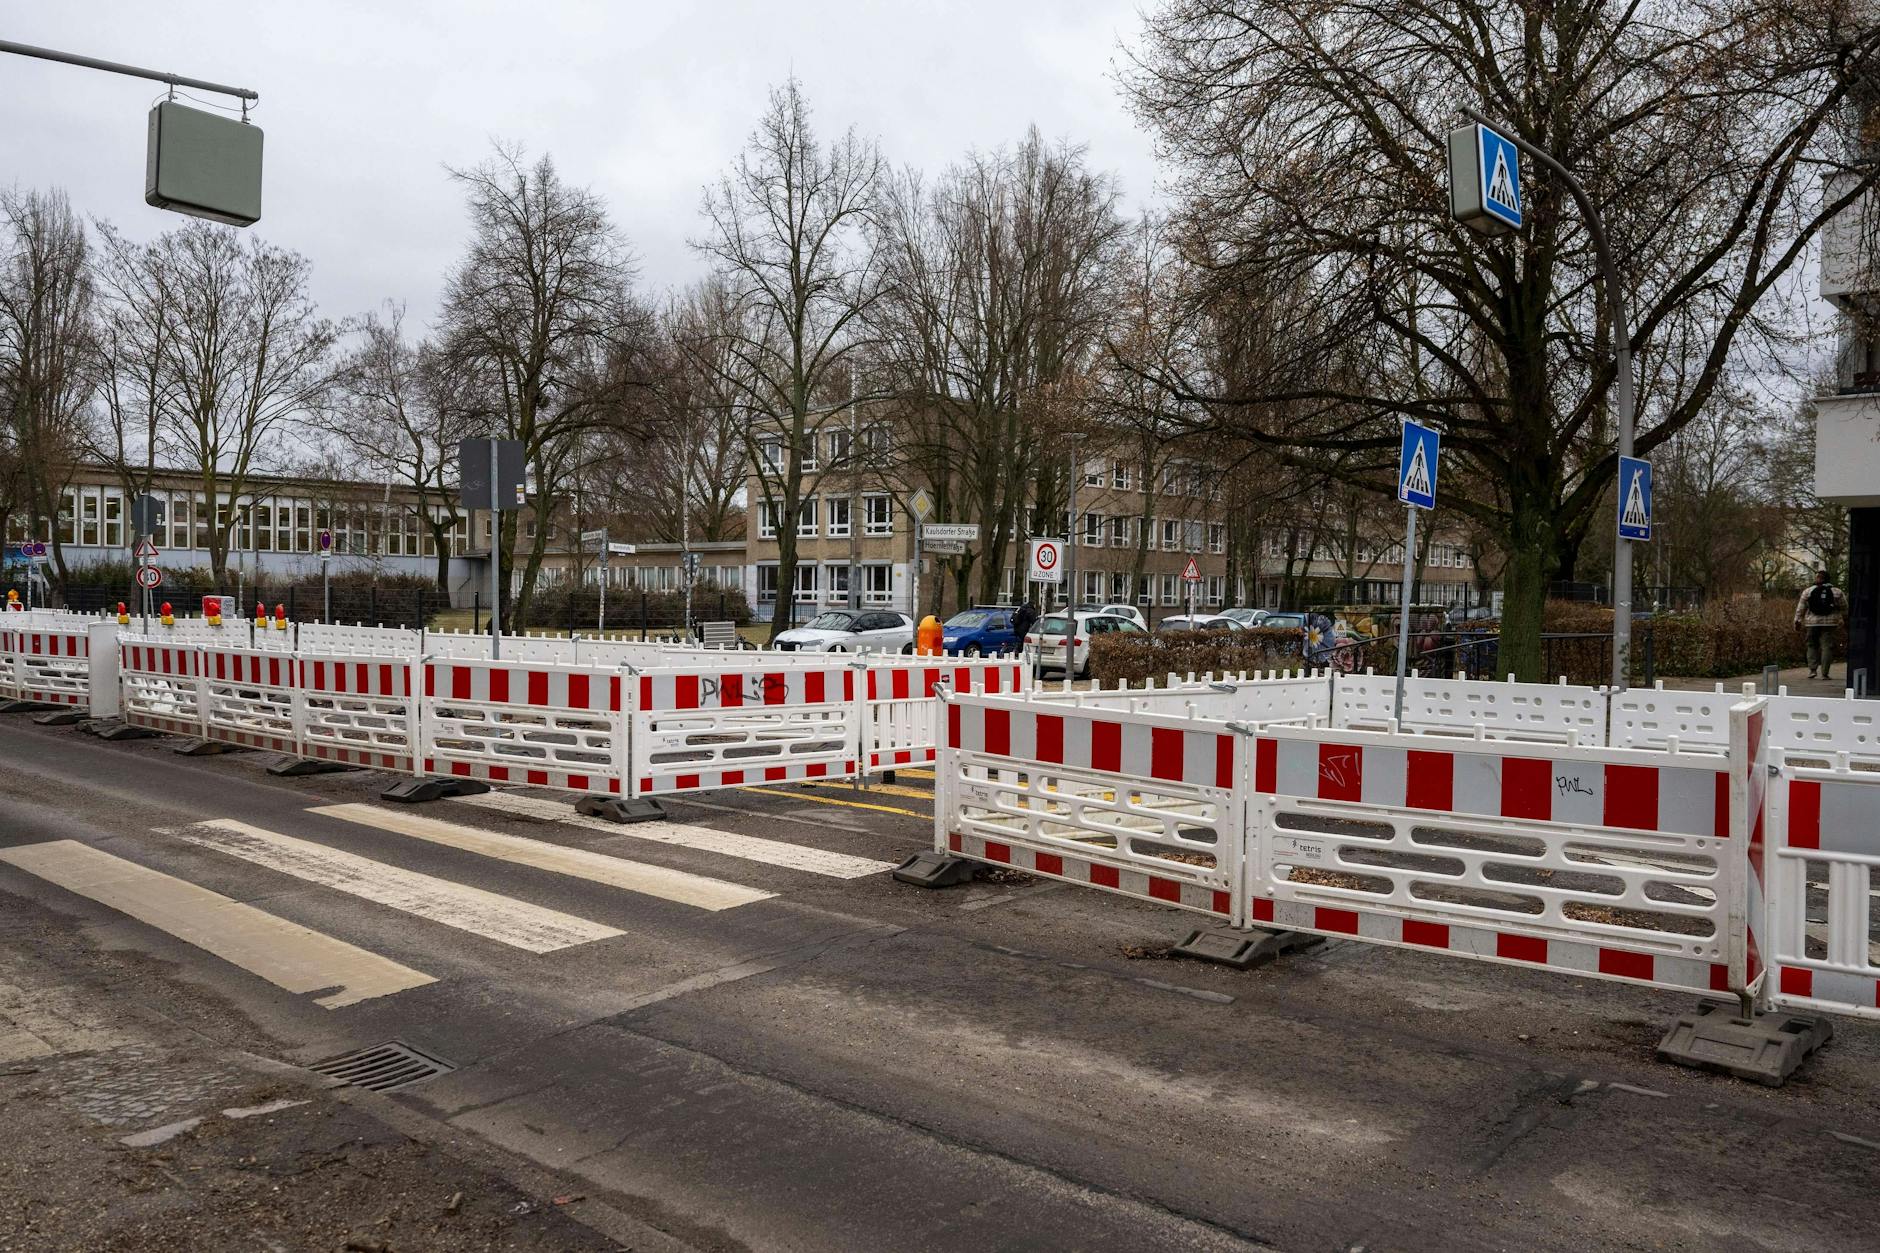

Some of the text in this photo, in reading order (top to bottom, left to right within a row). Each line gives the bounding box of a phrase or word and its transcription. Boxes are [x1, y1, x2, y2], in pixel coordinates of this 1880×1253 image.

[925, 527, 976, 538] Kaulsdorfer Straße
[1040, 550, 1053, 563] 30
[1038, 570, 1054, 578] ZONE
[1299, 844, 1322, 853] tetris
